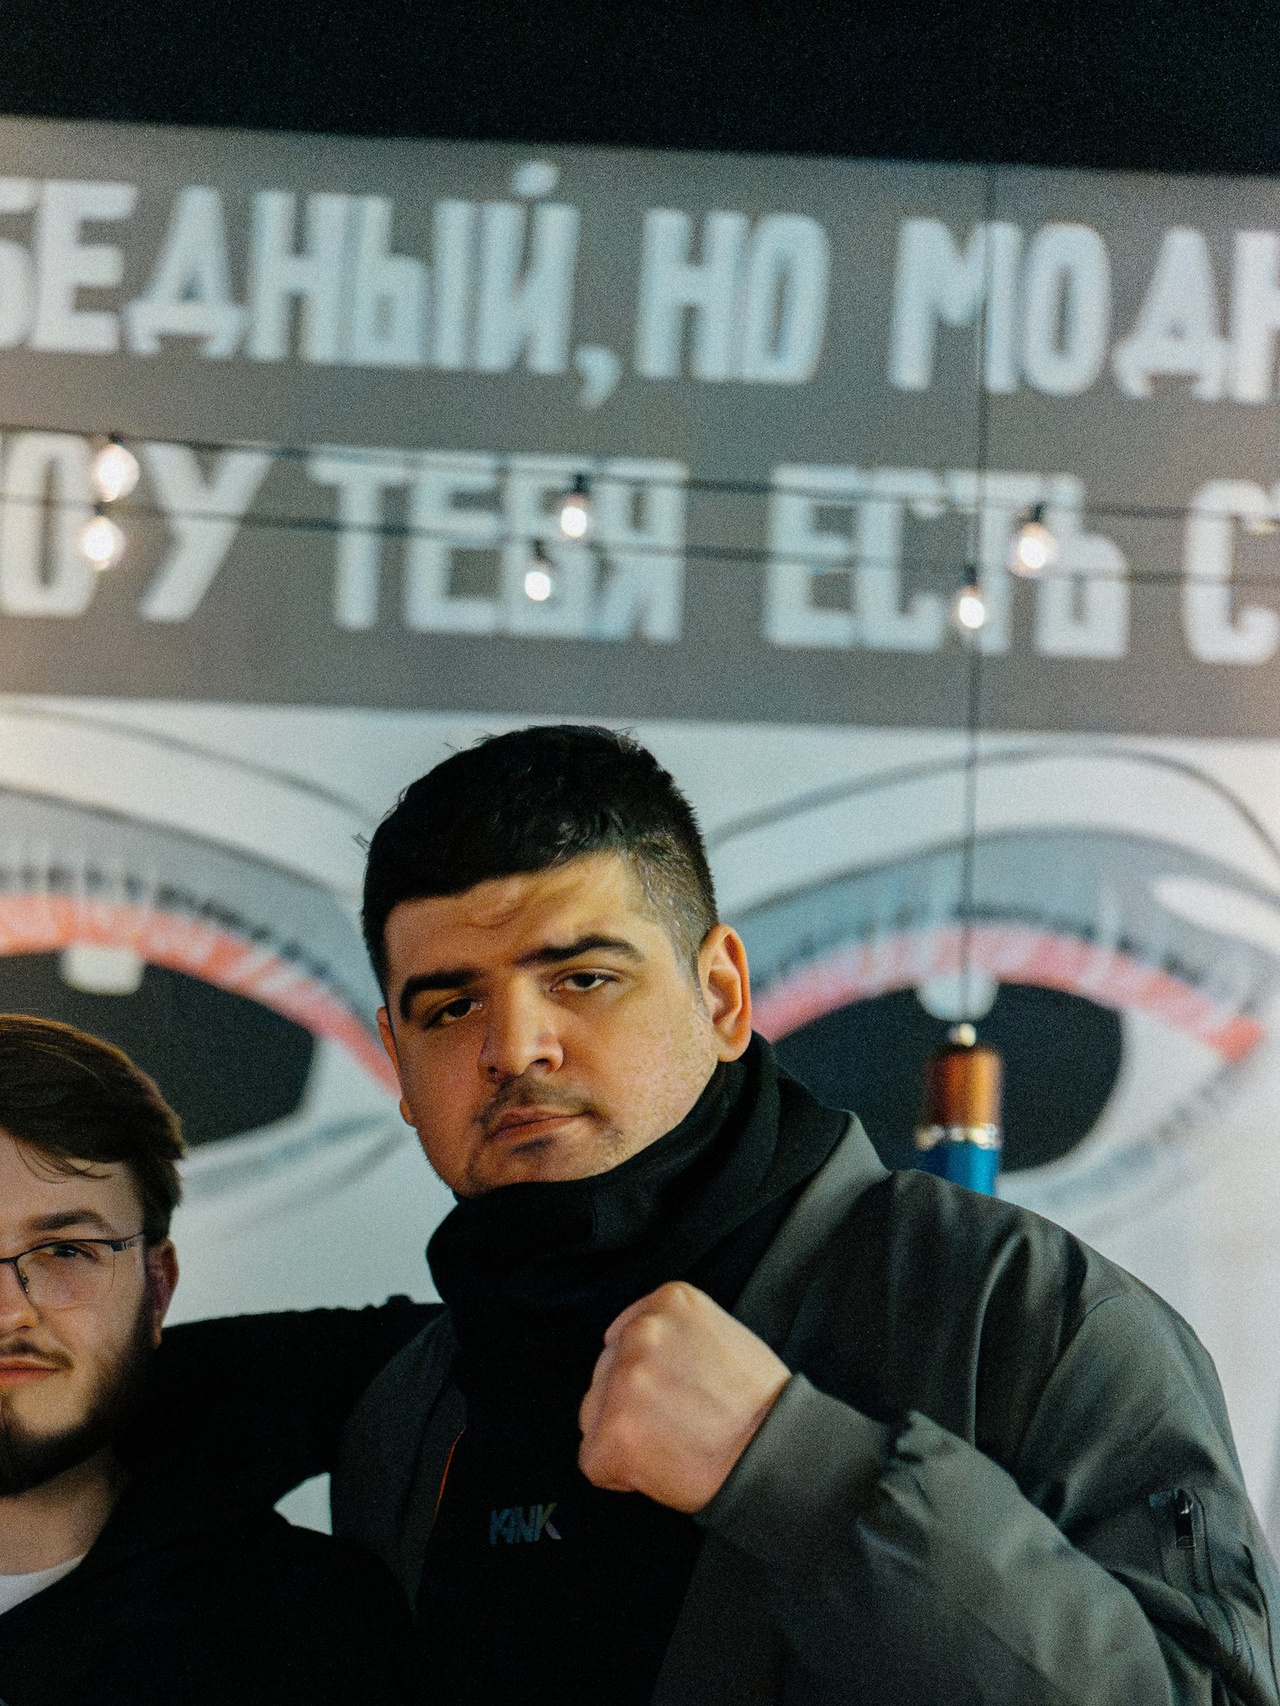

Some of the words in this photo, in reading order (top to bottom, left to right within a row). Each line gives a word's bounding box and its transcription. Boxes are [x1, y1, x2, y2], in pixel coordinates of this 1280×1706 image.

[636, 207, 831, 385] НО
[135, 441, 273, 624] У
[300, 445, 689, 644] ТЕБЯ
[762, 462, 1129, 661] ЕСТЬ
[1180, 476, 1280, 666] С
